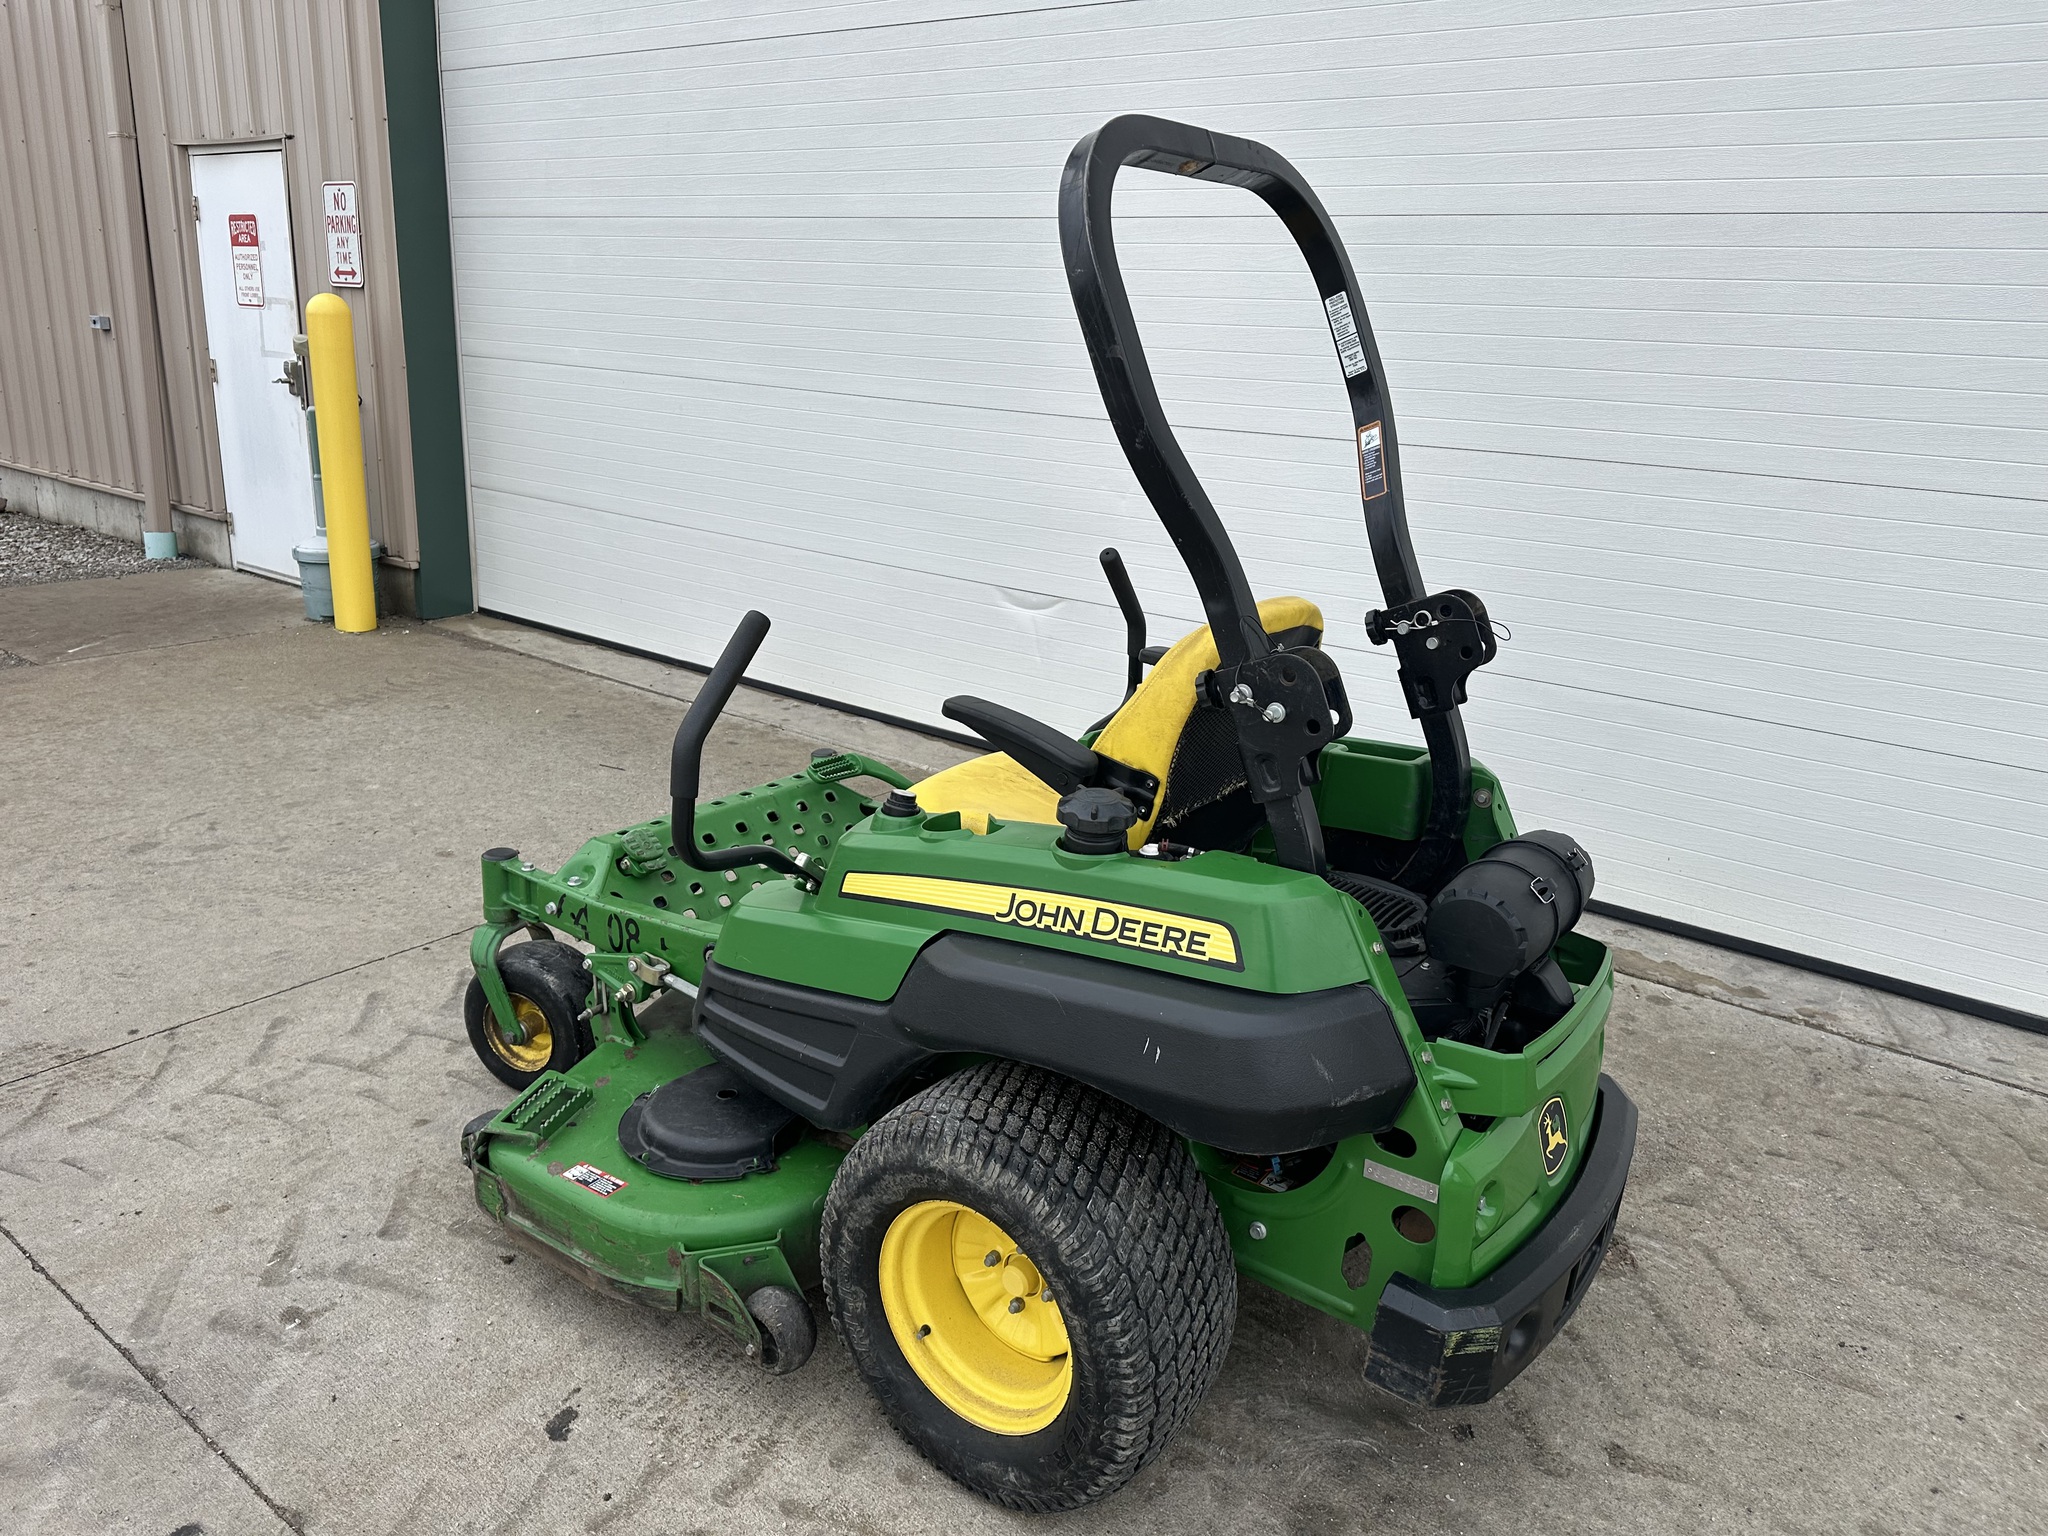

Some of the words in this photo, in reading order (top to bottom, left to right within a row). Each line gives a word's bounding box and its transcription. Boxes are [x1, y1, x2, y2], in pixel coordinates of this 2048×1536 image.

[333, 192, 347, 211] NO
[230, 220, 257, 237] RESTRICTED
[326, 215, 356, 234] PARKING
[238, 233, 251, 243] AREA
[336, 236, 349, 249] ANY
[235, 253, 258, 261] AUTHORIZED
[335, 251, 353, 265] TIME
[236, 263, 258, 271] PERSONNEL
[995, 892, 1086, 932] JOHN
[1090, 907, 1212, 957] DEERE
